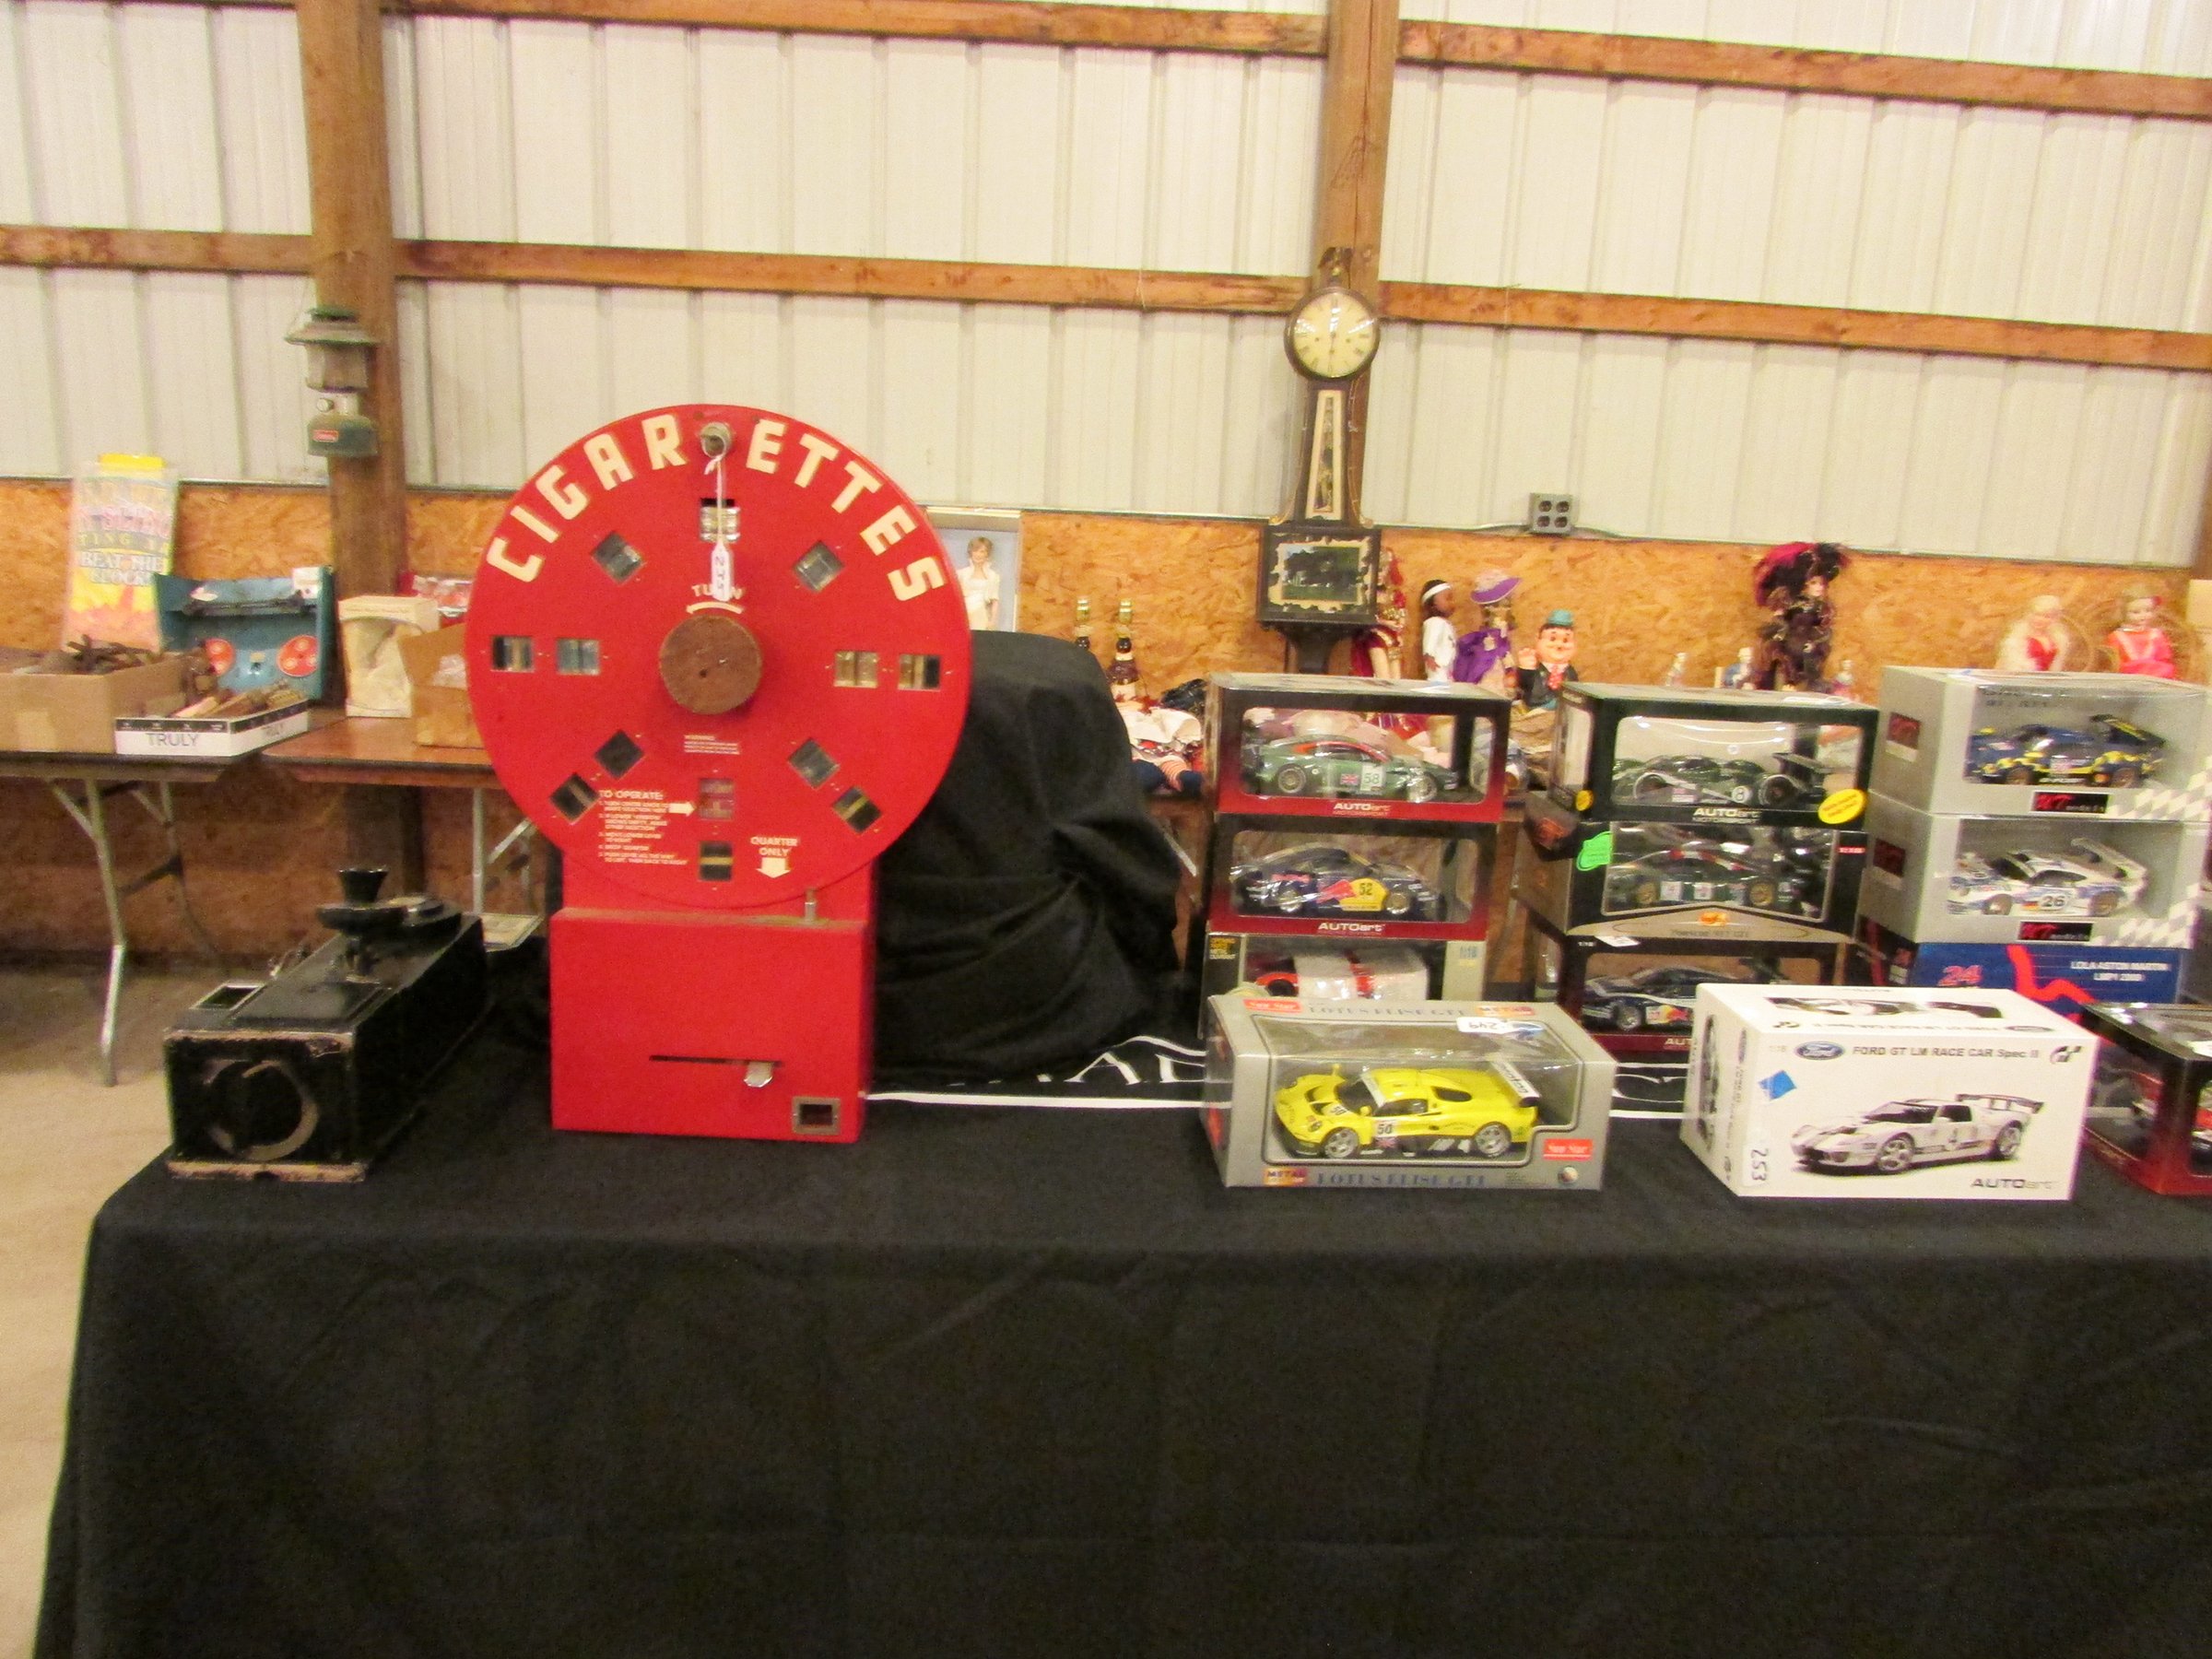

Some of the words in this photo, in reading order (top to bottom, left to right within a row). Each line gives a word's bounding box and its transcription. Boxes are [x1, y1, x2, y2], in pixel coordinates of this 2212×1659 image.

[487, 414, 947, 602] CIGARETTES
[691, 582, 743, 600] TUN
[146, 733, 199, 747] TRULY
[1363, 771, 1380, 784] 58
[598, 790, 613, 799] TO
[750, 836, 798, 847] QUARTER
[759, 847, 791, 857] ONLY
[1359, 882, 1373, 896] 52
[2042, 895, 2065, 907] 26
[1318, 922, 1386, 934] AUTOart
[1937, 964, 1983, 987] 24
[1853, 1045, 1887, 1056] FORD
[1890, 1046, 1907, 1056] GT
[1911, 1046, 1928, 1057] LM
[1932, 1047, 1964, 1058] RACE
[1968, 1048, 1994, 1058] CAR
[1997, 1048, 2027, 1060] Spec
[1377, 1124, 1394, 1135] 50
[1750, 1148, 1769, 1182] 253
